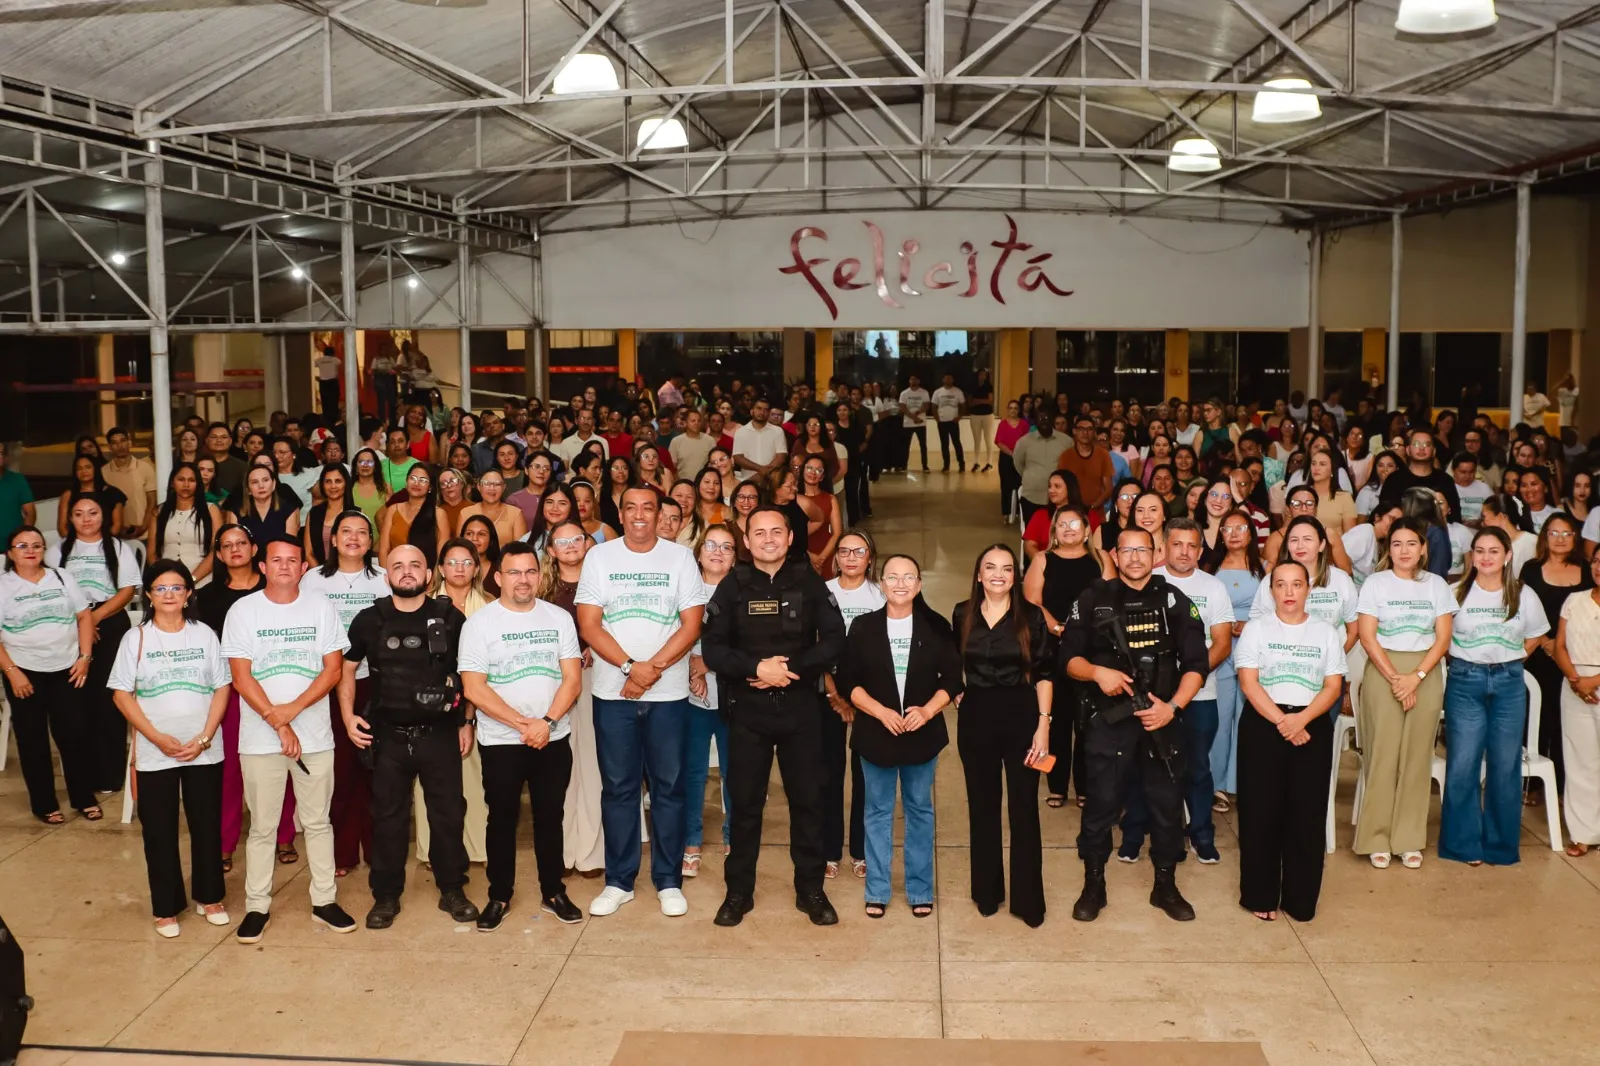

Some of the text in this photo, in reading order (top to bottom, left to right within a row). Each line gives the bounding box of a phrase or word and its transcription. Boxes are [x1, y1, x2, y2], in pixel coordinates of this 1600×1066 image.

[608, 573, 638, 581] SEDUC
[257, 627, 315, 637] SEDUC PIRIPIRI
[501, 632, 530, 641] SEDUC
[1268, 643, 1294, 651] SEDUC
